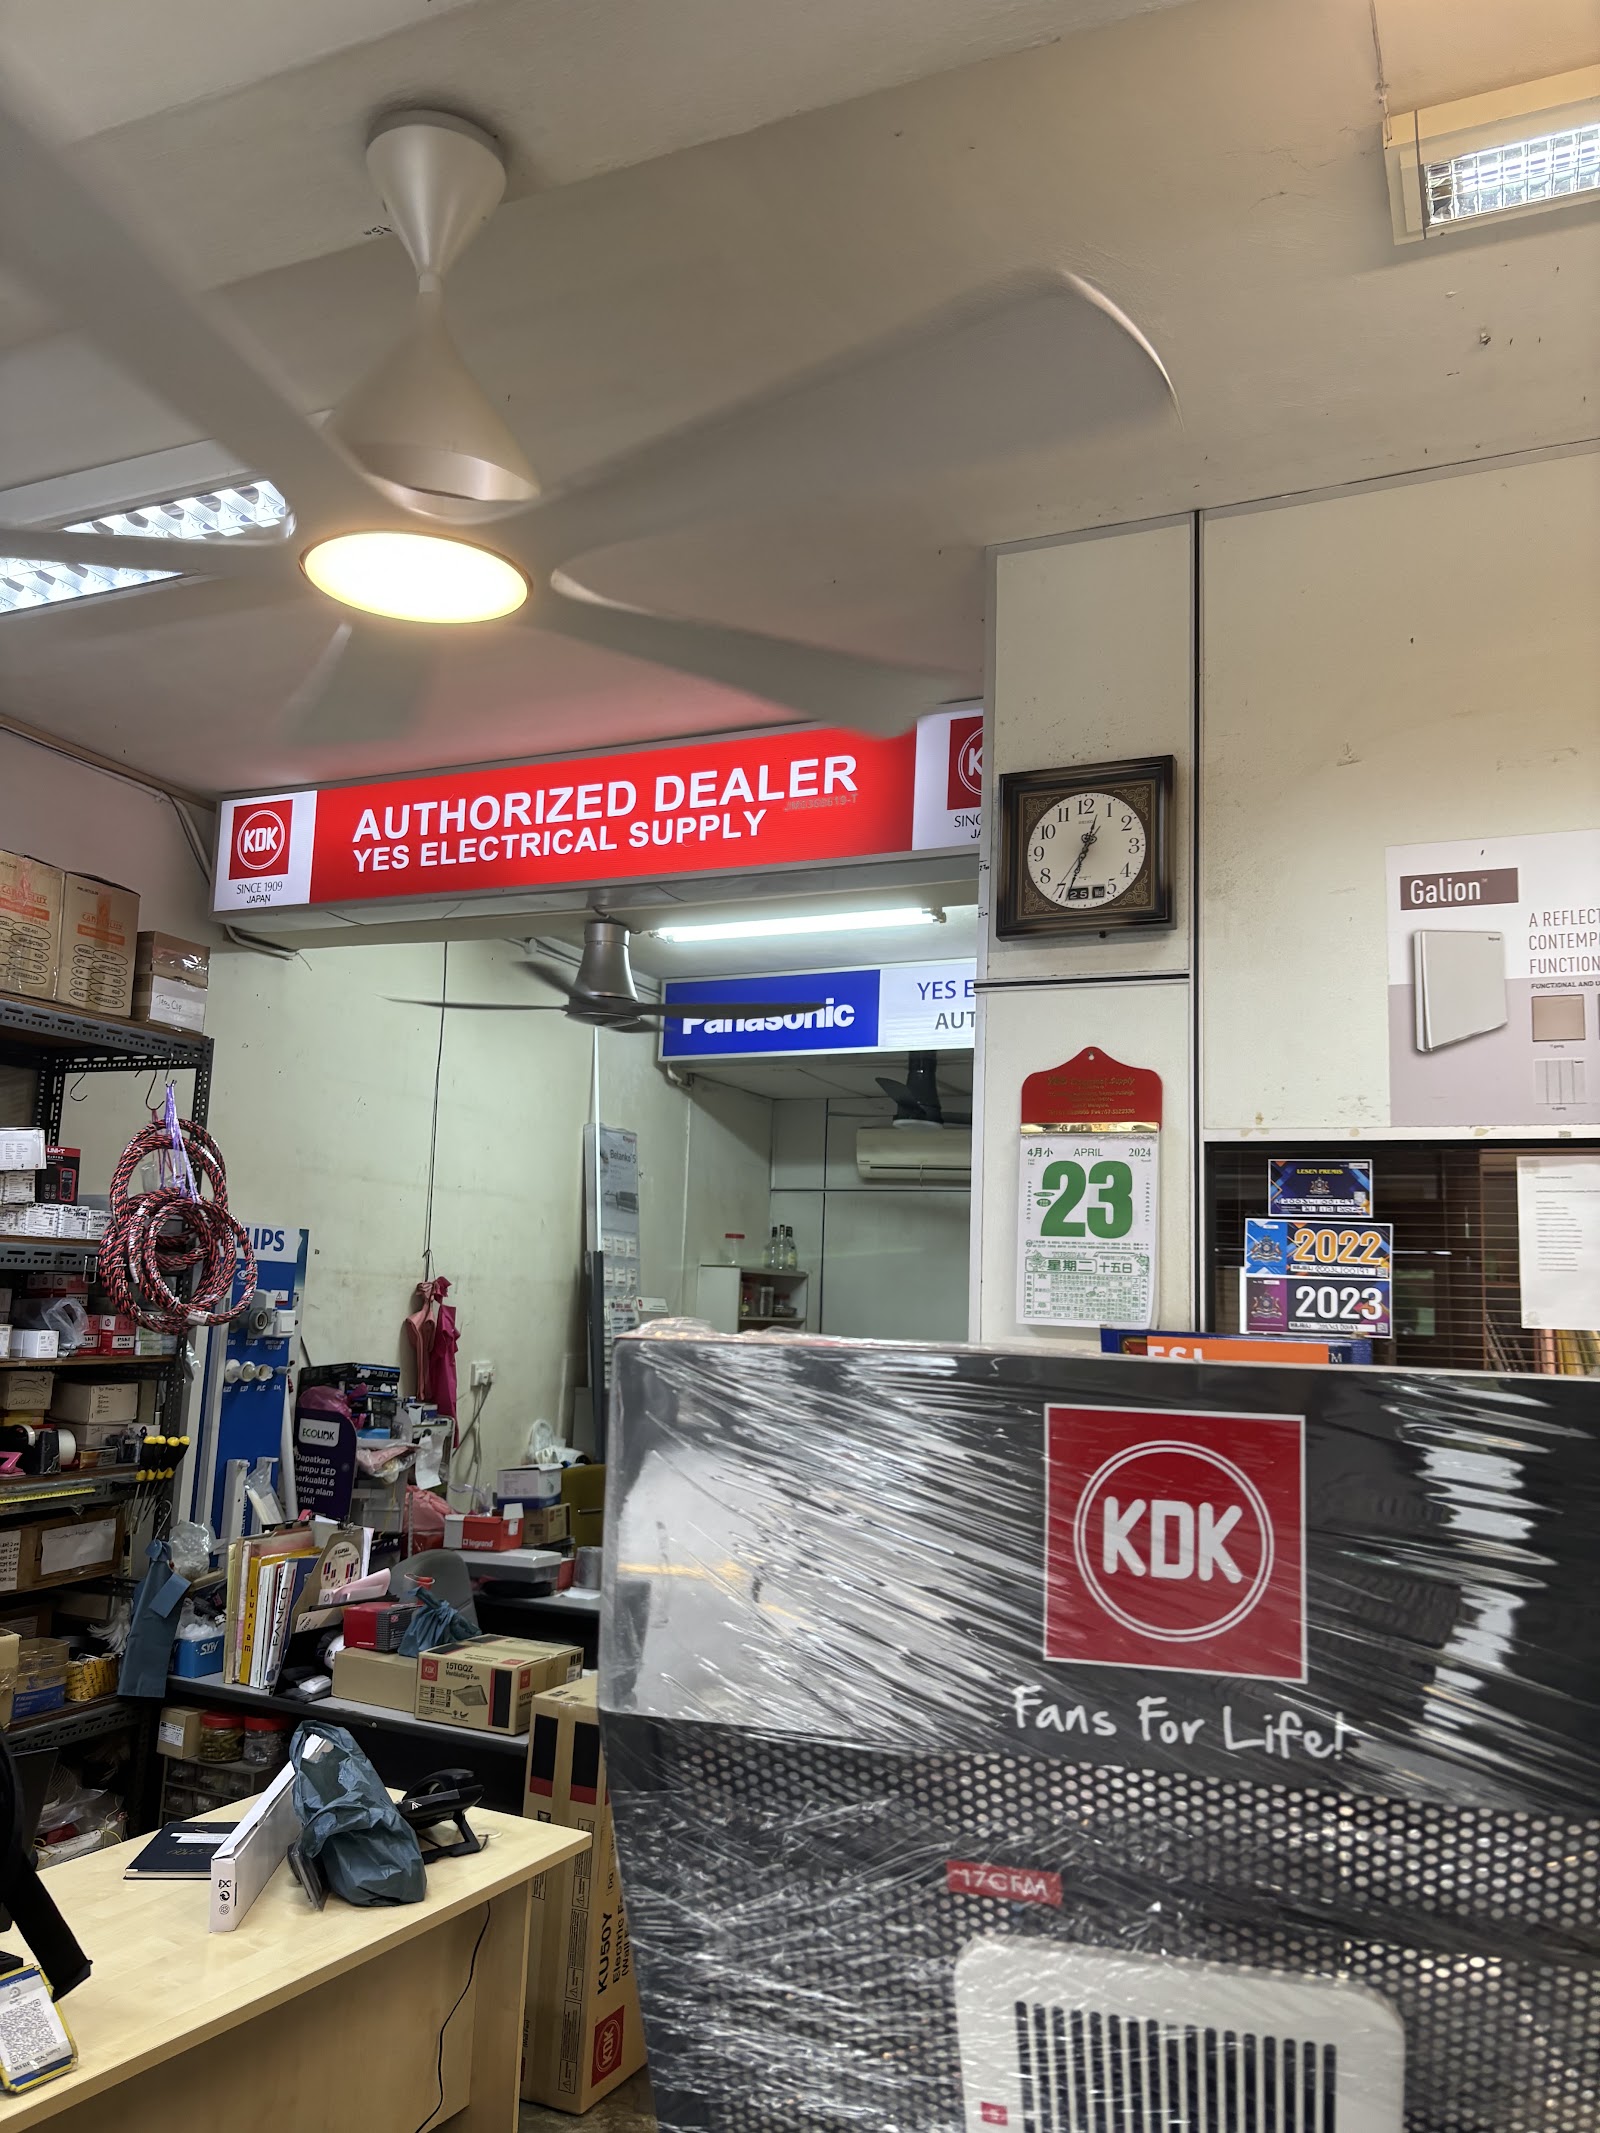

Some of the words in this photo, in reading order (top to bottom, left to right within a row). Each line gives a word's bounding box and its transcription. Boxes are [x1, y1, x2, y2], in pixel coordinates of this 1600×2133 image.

[352, 779, 637, 842] AUTHORIZED
[653, 754, 858, 814] DEALER
[1077, 798, 1095, 815] 12
[1057, 807, 1070, 823] 11
[1120, 815, 1133, 831] 2
[243, 825, 279, 854] KDK
[353, 845, 410, 873] YES
[419, 824, 618, 867] ELECTRICAL
[627, 808, 768, 849] SUPPLY
[1040, 824, 1056, 840] 10
[1033, 845, 1045, 862] 9
[1128, 837, 1140, 854] 3
[1040, 868, 1051, 884] 8
[1119, 862, 1132, 878] 4
[236, 884, 262, 895] SINCE
[264, 881, 283, 893] 1909
[1106, 878, 1117, 895] 5
[1410, 878, 1481, 905] Galion
[246, 894, 271, 904] JAPAN
[1528, 913, 1538, 928] A
[1528, 931, 1600, 951] CONTEMP
[917, 980, 957, 1000] YES
[1073, 1148, 1103, 1157] APRIL
[1128, 1148, 1151, 1157] 2024
[1040, 1160, 1132, 1239] 23
[1293, 1228, 1382, 1265] 2022
[1047, 1260, 1093, 1272] 星期二
[1099, 1263, 1132, 1273] 十五日
[1295, 1286, 1383, 1321] 2023
[321, 1467, 336, 1476] LED
[316, 1487, 334, 1497] alam
[469, 1539, 493, 1548] legrand
[1103, 1496, 1243, 1583] KDK
[244, 1588, 255, 1652] Luxram
[445, 1669, 470, 1680] Ventilating
[446, 1661, 473, 1673] 15TGQZ
[1012, 1684, 1117, 1736] Fans
[1137, 1696, 1205, 1745] For
[1222, 1703, 1345, 1760] Life!
[597, 1912, 613, 1995] KU50Y
[613, 1917, 624, 1984] Electric
[621, 1941, 630, 1976] (Wall
[602, 2026, 615, 2066] KDK
